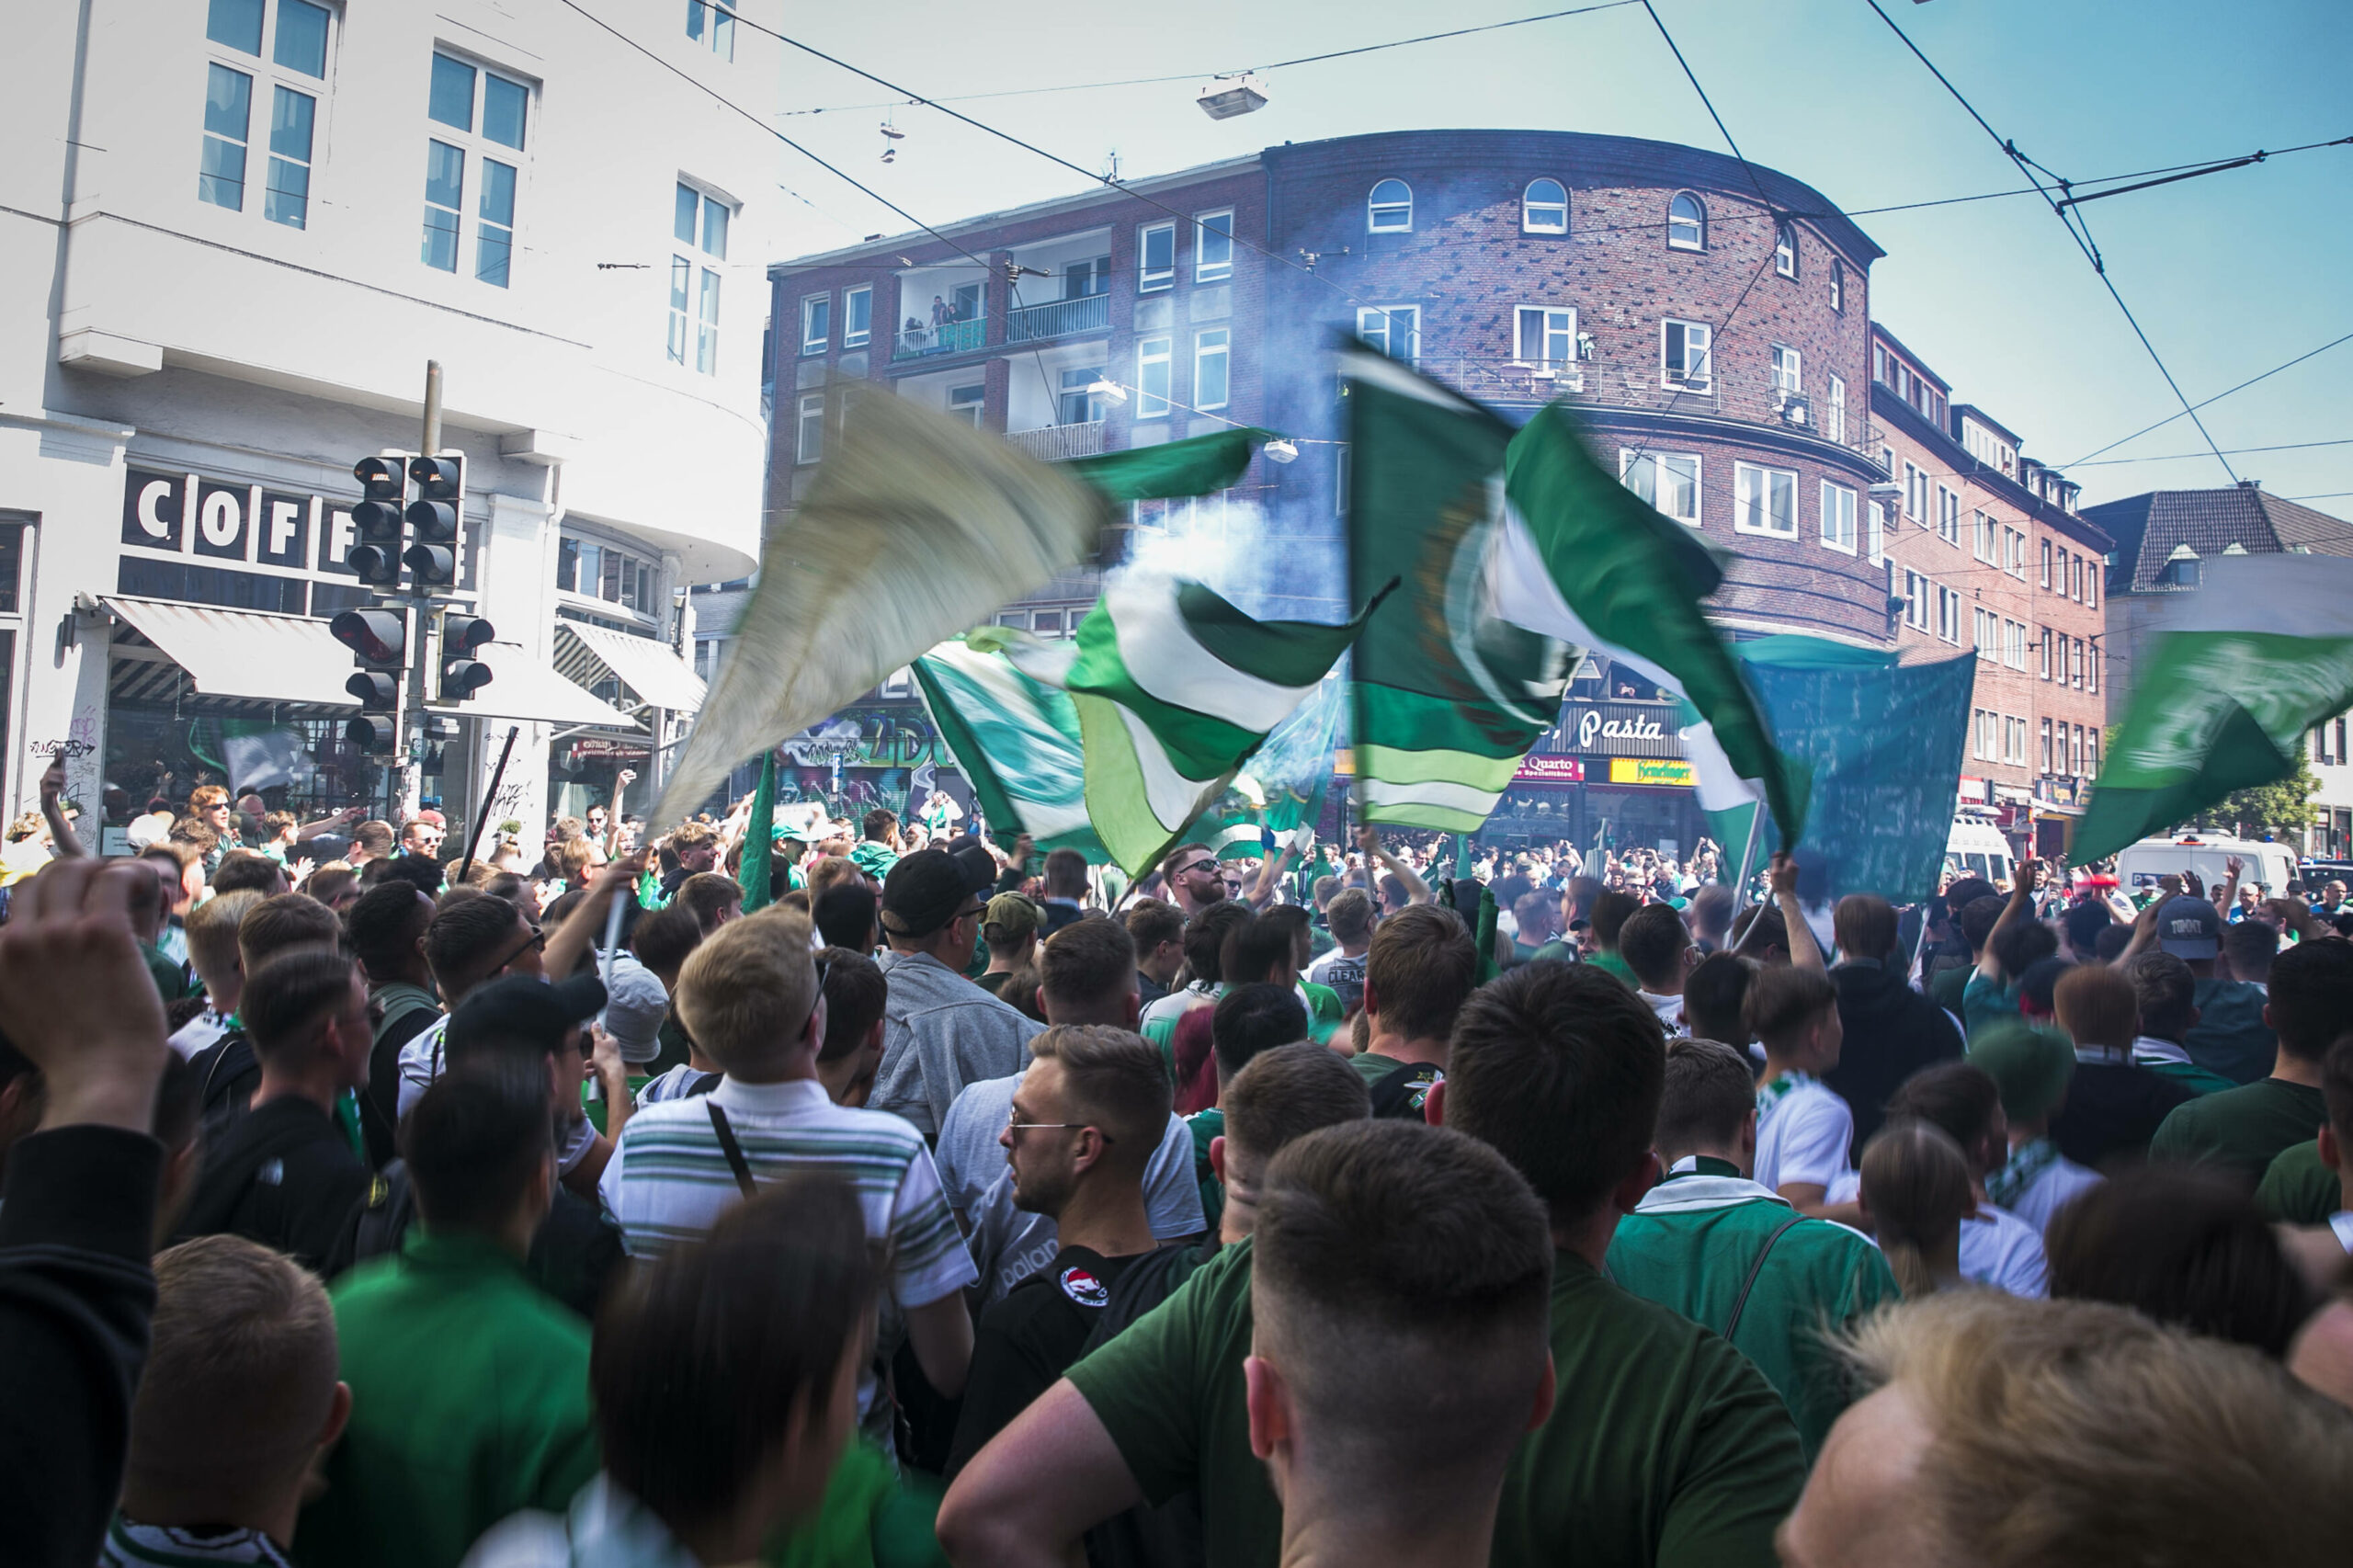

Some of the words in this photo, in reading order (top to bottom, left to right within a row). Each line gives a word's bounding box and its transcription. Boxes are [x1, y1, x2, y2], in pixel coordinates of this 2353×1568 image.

[138, 480, 467, 579] COFF
[1580, 710, 1664, 747] Pasta
[1529, 757, 1573, 771] Quarto
